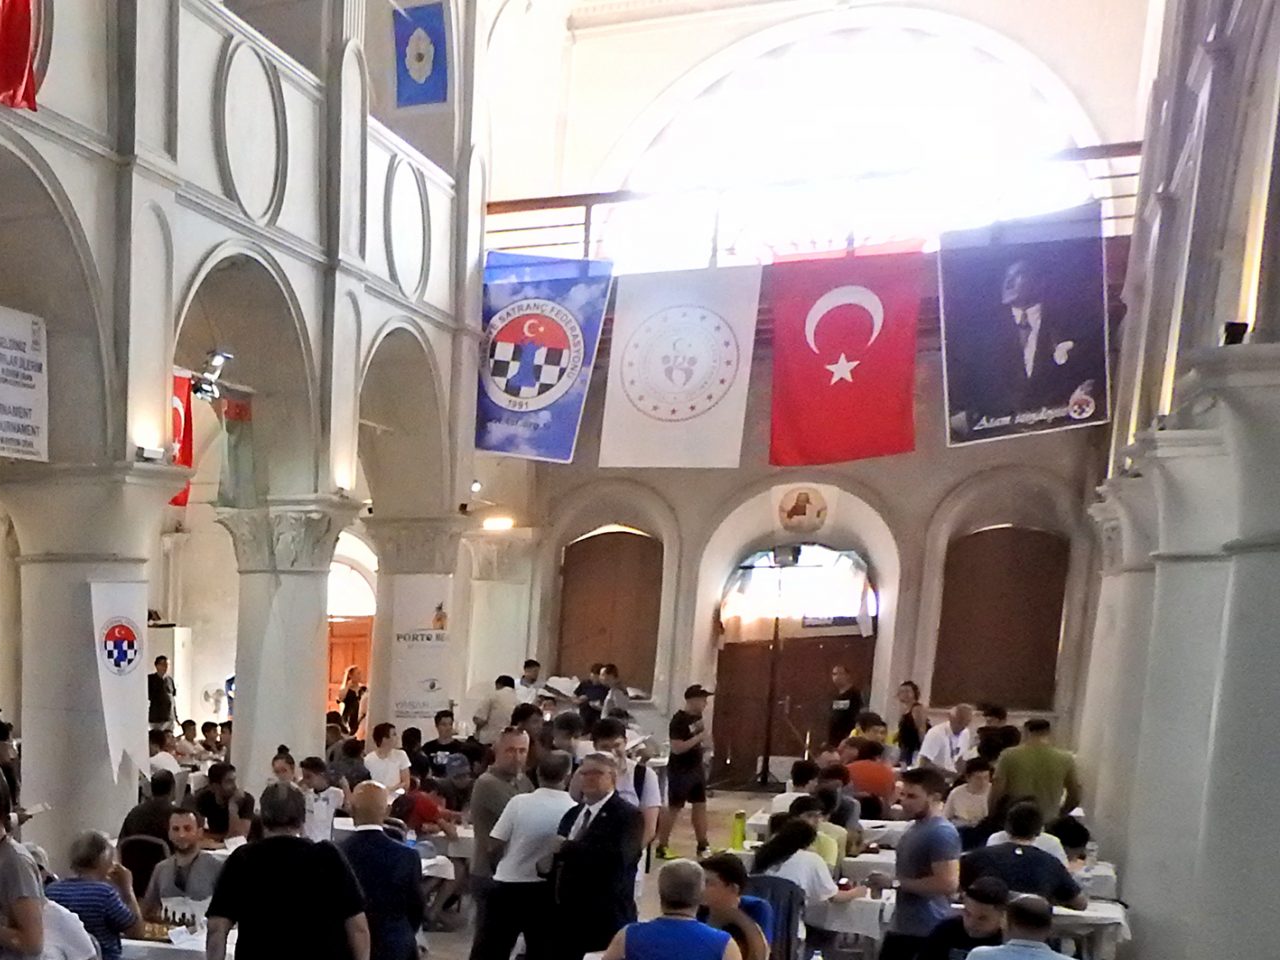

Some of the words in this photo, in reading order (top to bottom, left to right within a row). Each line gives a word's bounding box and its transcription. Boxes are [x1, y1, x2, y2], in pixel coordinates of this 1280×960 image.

[498, 303, 548, 323] SATRANÇ
[549, 306, 581, 379] FEDERASYONU
[507, 398, 530, 410] 1991
[396, 632, 432, 642] PORTO
